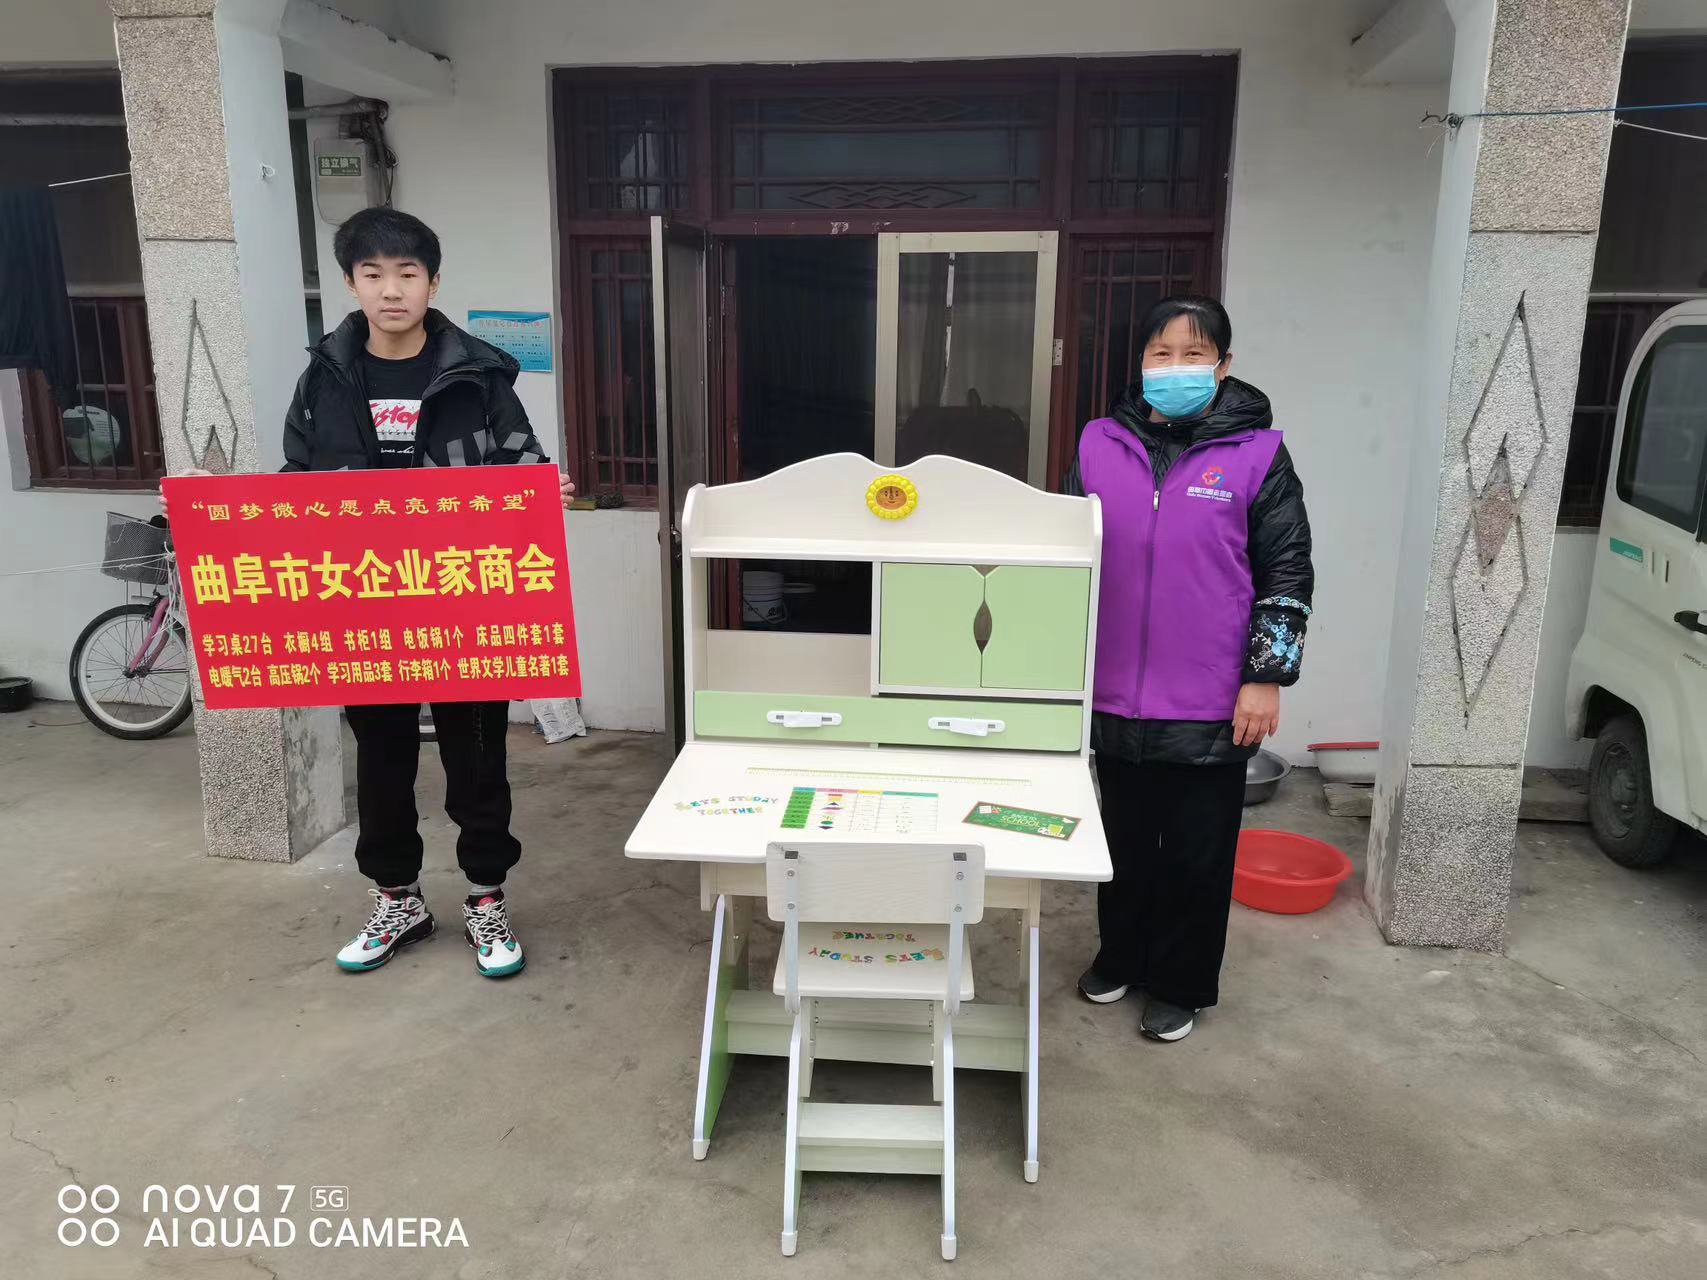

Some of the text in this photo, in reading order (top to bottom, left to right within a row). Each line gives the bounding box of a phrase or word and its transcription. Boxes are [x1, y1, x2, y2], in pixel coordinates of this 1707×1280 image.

[190, 543, 556, 605] 曲阜市女企业家商会
[202, 632, 273, 657] 学习桌27台
[343, 628, 393, 652] 书柜1组
[403, 625, 464, 649] 电饭锅1个
[475, 621, 565, 647] 床品四件套1套
[208, 653, 569, 688] 电暖气2台 高压锅2个 学习用品3套 行李箱1个 世界文学儿童名著1套
[697, 806, 764, 816] TOGETHER
[1002, 815, 1040, 828] SCHOOL
